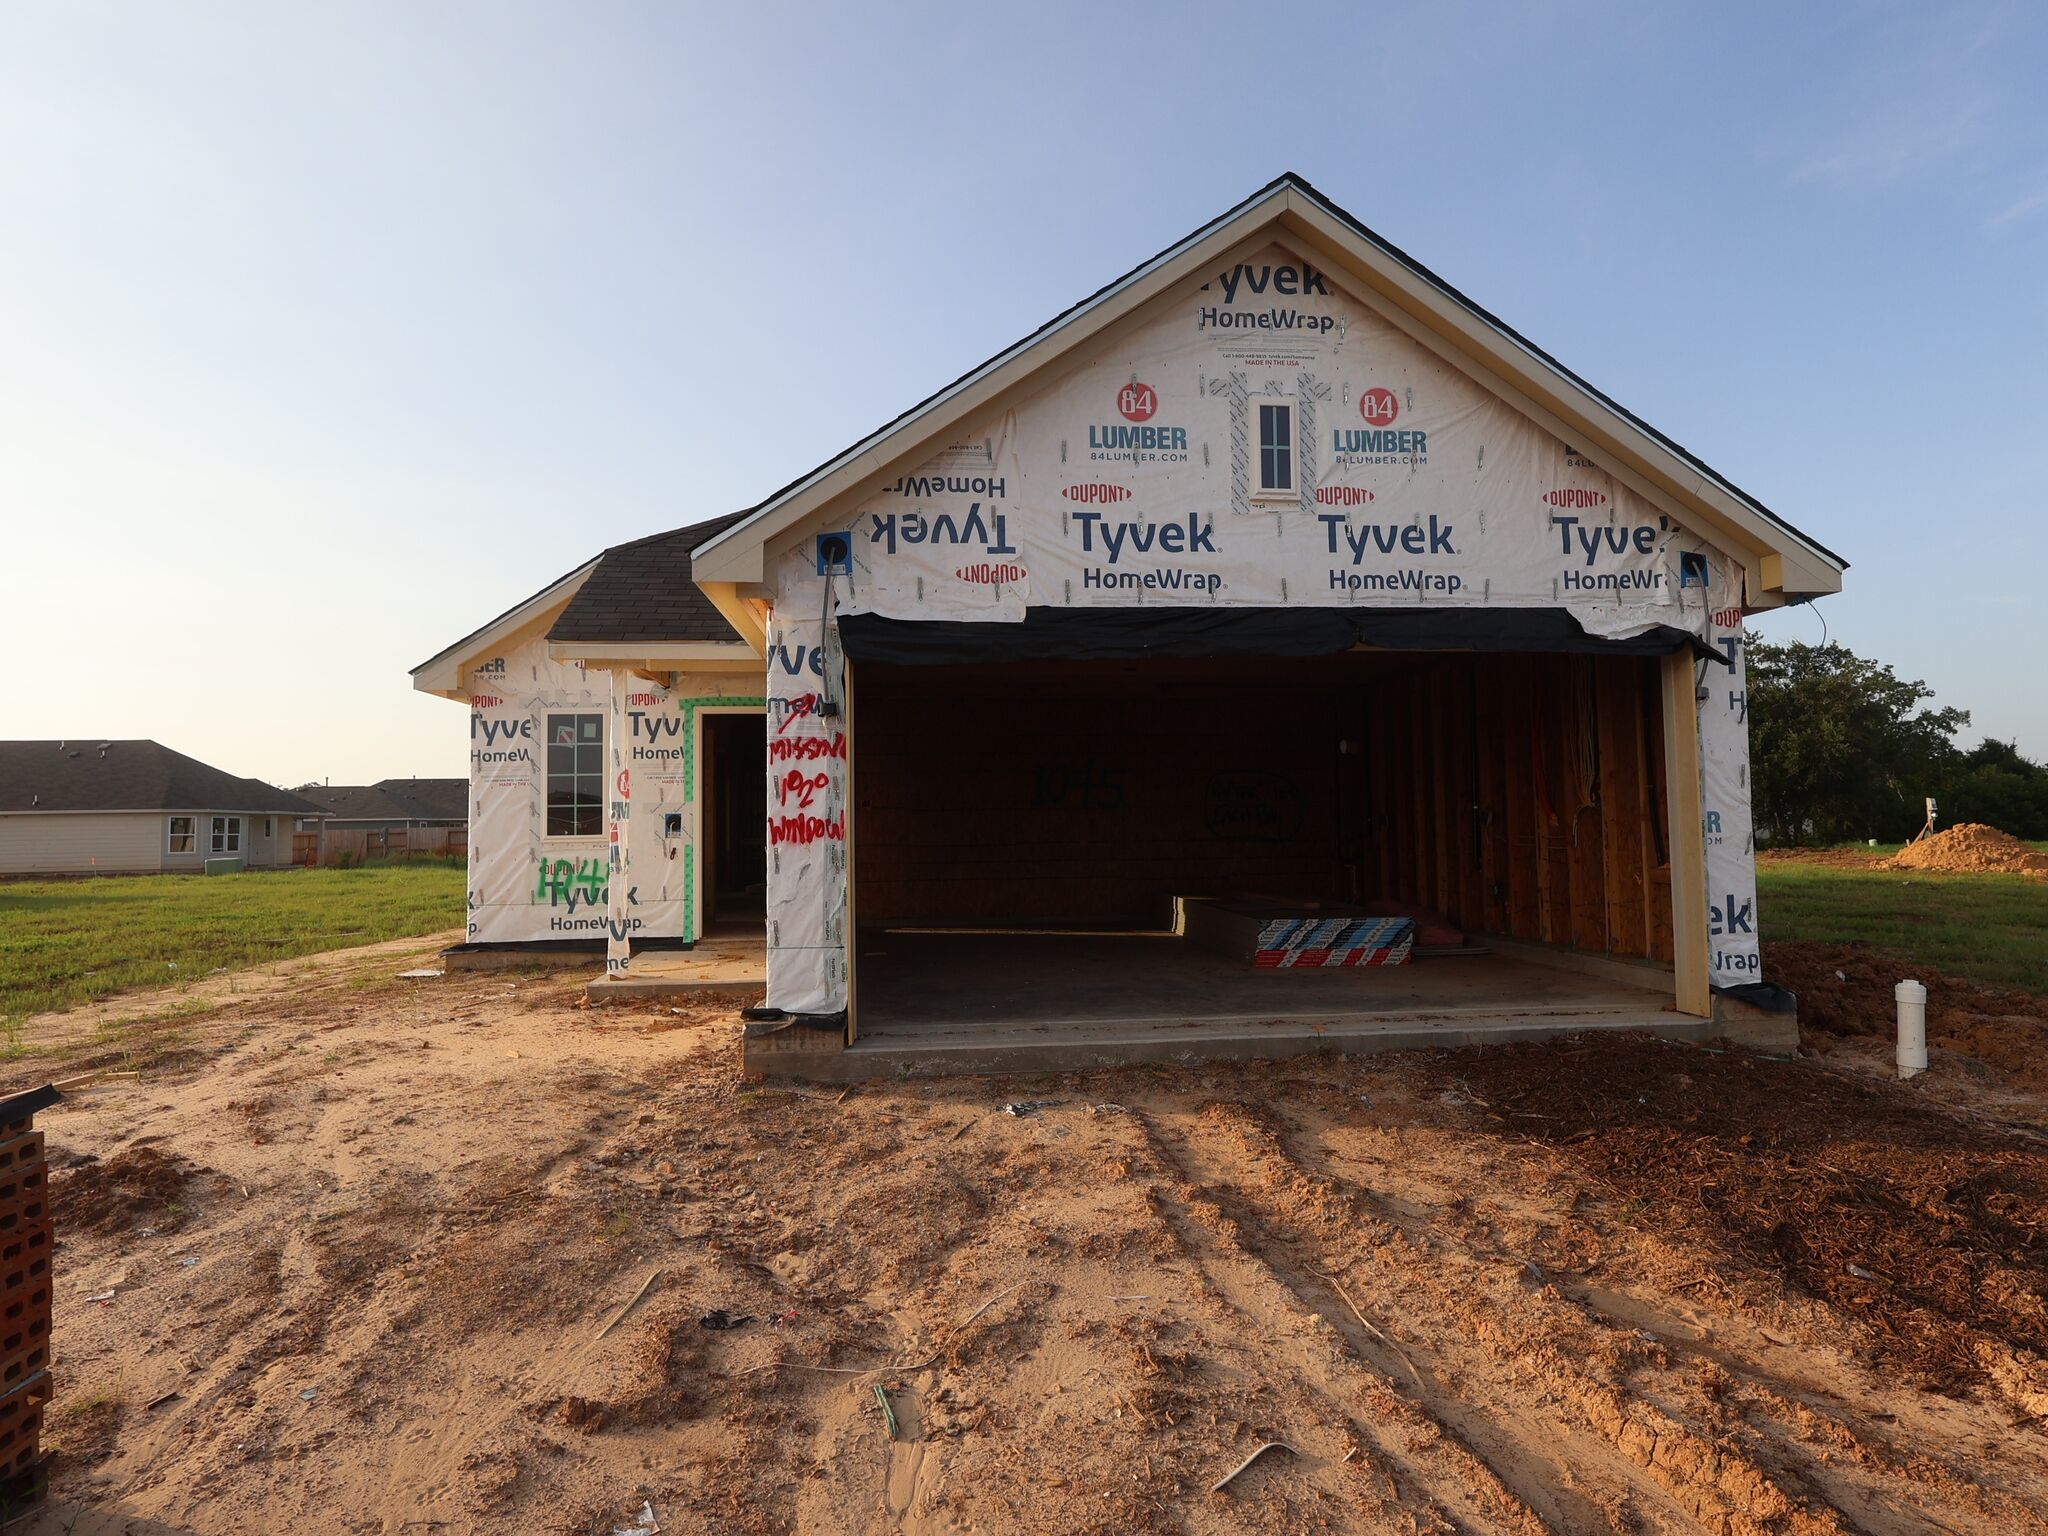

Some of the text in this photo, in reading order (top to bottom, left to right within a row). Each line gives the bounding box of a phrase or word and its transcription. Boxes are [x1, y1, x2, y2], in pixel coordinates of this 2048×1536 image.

[1201, 263, 1328, 304] yvek
[1201, 307, 1335, 334] HomeWrap
[1121, 389, 1153, 414] 84
[1364, 394, 1394, 419] 84
[1089, 425, 1187, 450] LUMBER
[1333, 429, 1427, 453] LUMBER
[882, 477, 1006, 498] HomeWr
[1071, 483, 1125, 504] DUPONT
[1316, 486, 1368, 506] DUPONT
[1550, 488, 1600, 508] DUPONT
[871, 502, 1016, 554] Tyvek
[1072, 512, 1217, 564] Tyvek
[1318, 514, 1456, 565] Tyvek
[963, 564, 1018, 584] DUPONT
[1084, 567, 1222, 594] HomeWrap
[1329, 569, 1462, 595] HomeWrap
[1564, 569, 1669, 590] HomeWr
[628, 711, 684, 743] Tyv
[537, 856, 611, 898] 104
